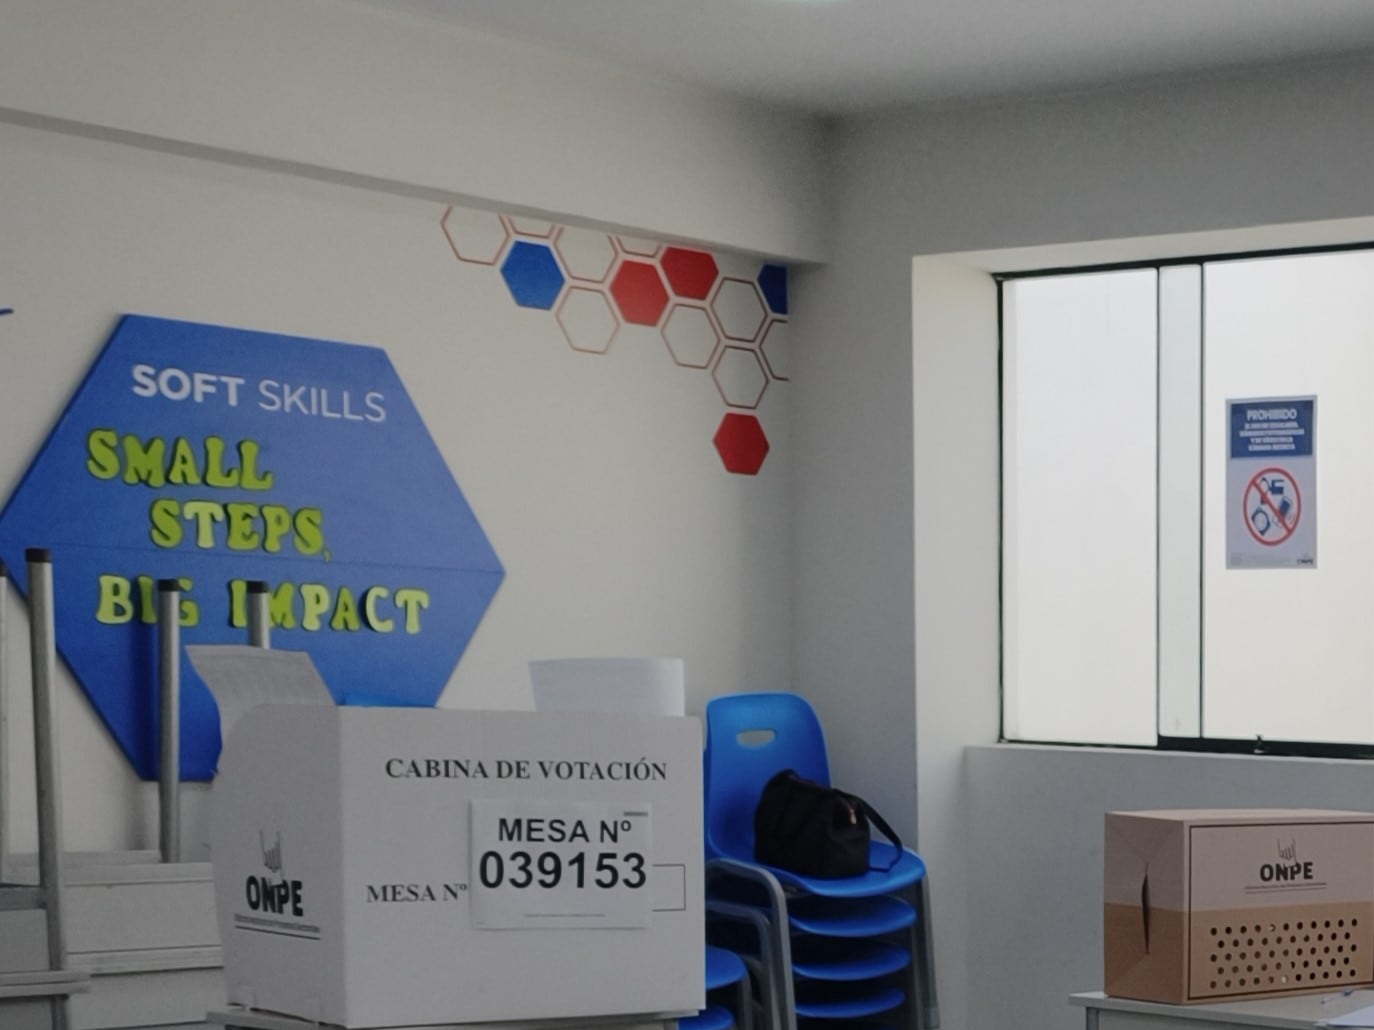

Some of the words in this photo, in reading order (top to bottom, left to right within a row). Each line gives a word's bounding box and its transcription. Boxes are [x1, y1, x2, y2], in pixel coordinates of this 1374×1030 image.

[132, 364, 245, 406] SOFT
[258, 380, 387, 423] SKILLS
[87, 428, 273, 490] SMALL
[230, 578, 429, 634] IMPACT
[385, 758, 489, 779] CABINA
[496, 760, 531, 780] DE
[537, 757, 667, 781] VOTACIÓN
[498, 818, 590, 843] MESA
[479, 851, 646, 889] 039153
[1260, 862, 1314, 882] ONPE
[246, 875, 304, 917] ONPE
[366, 884, 437, 903] MESA
